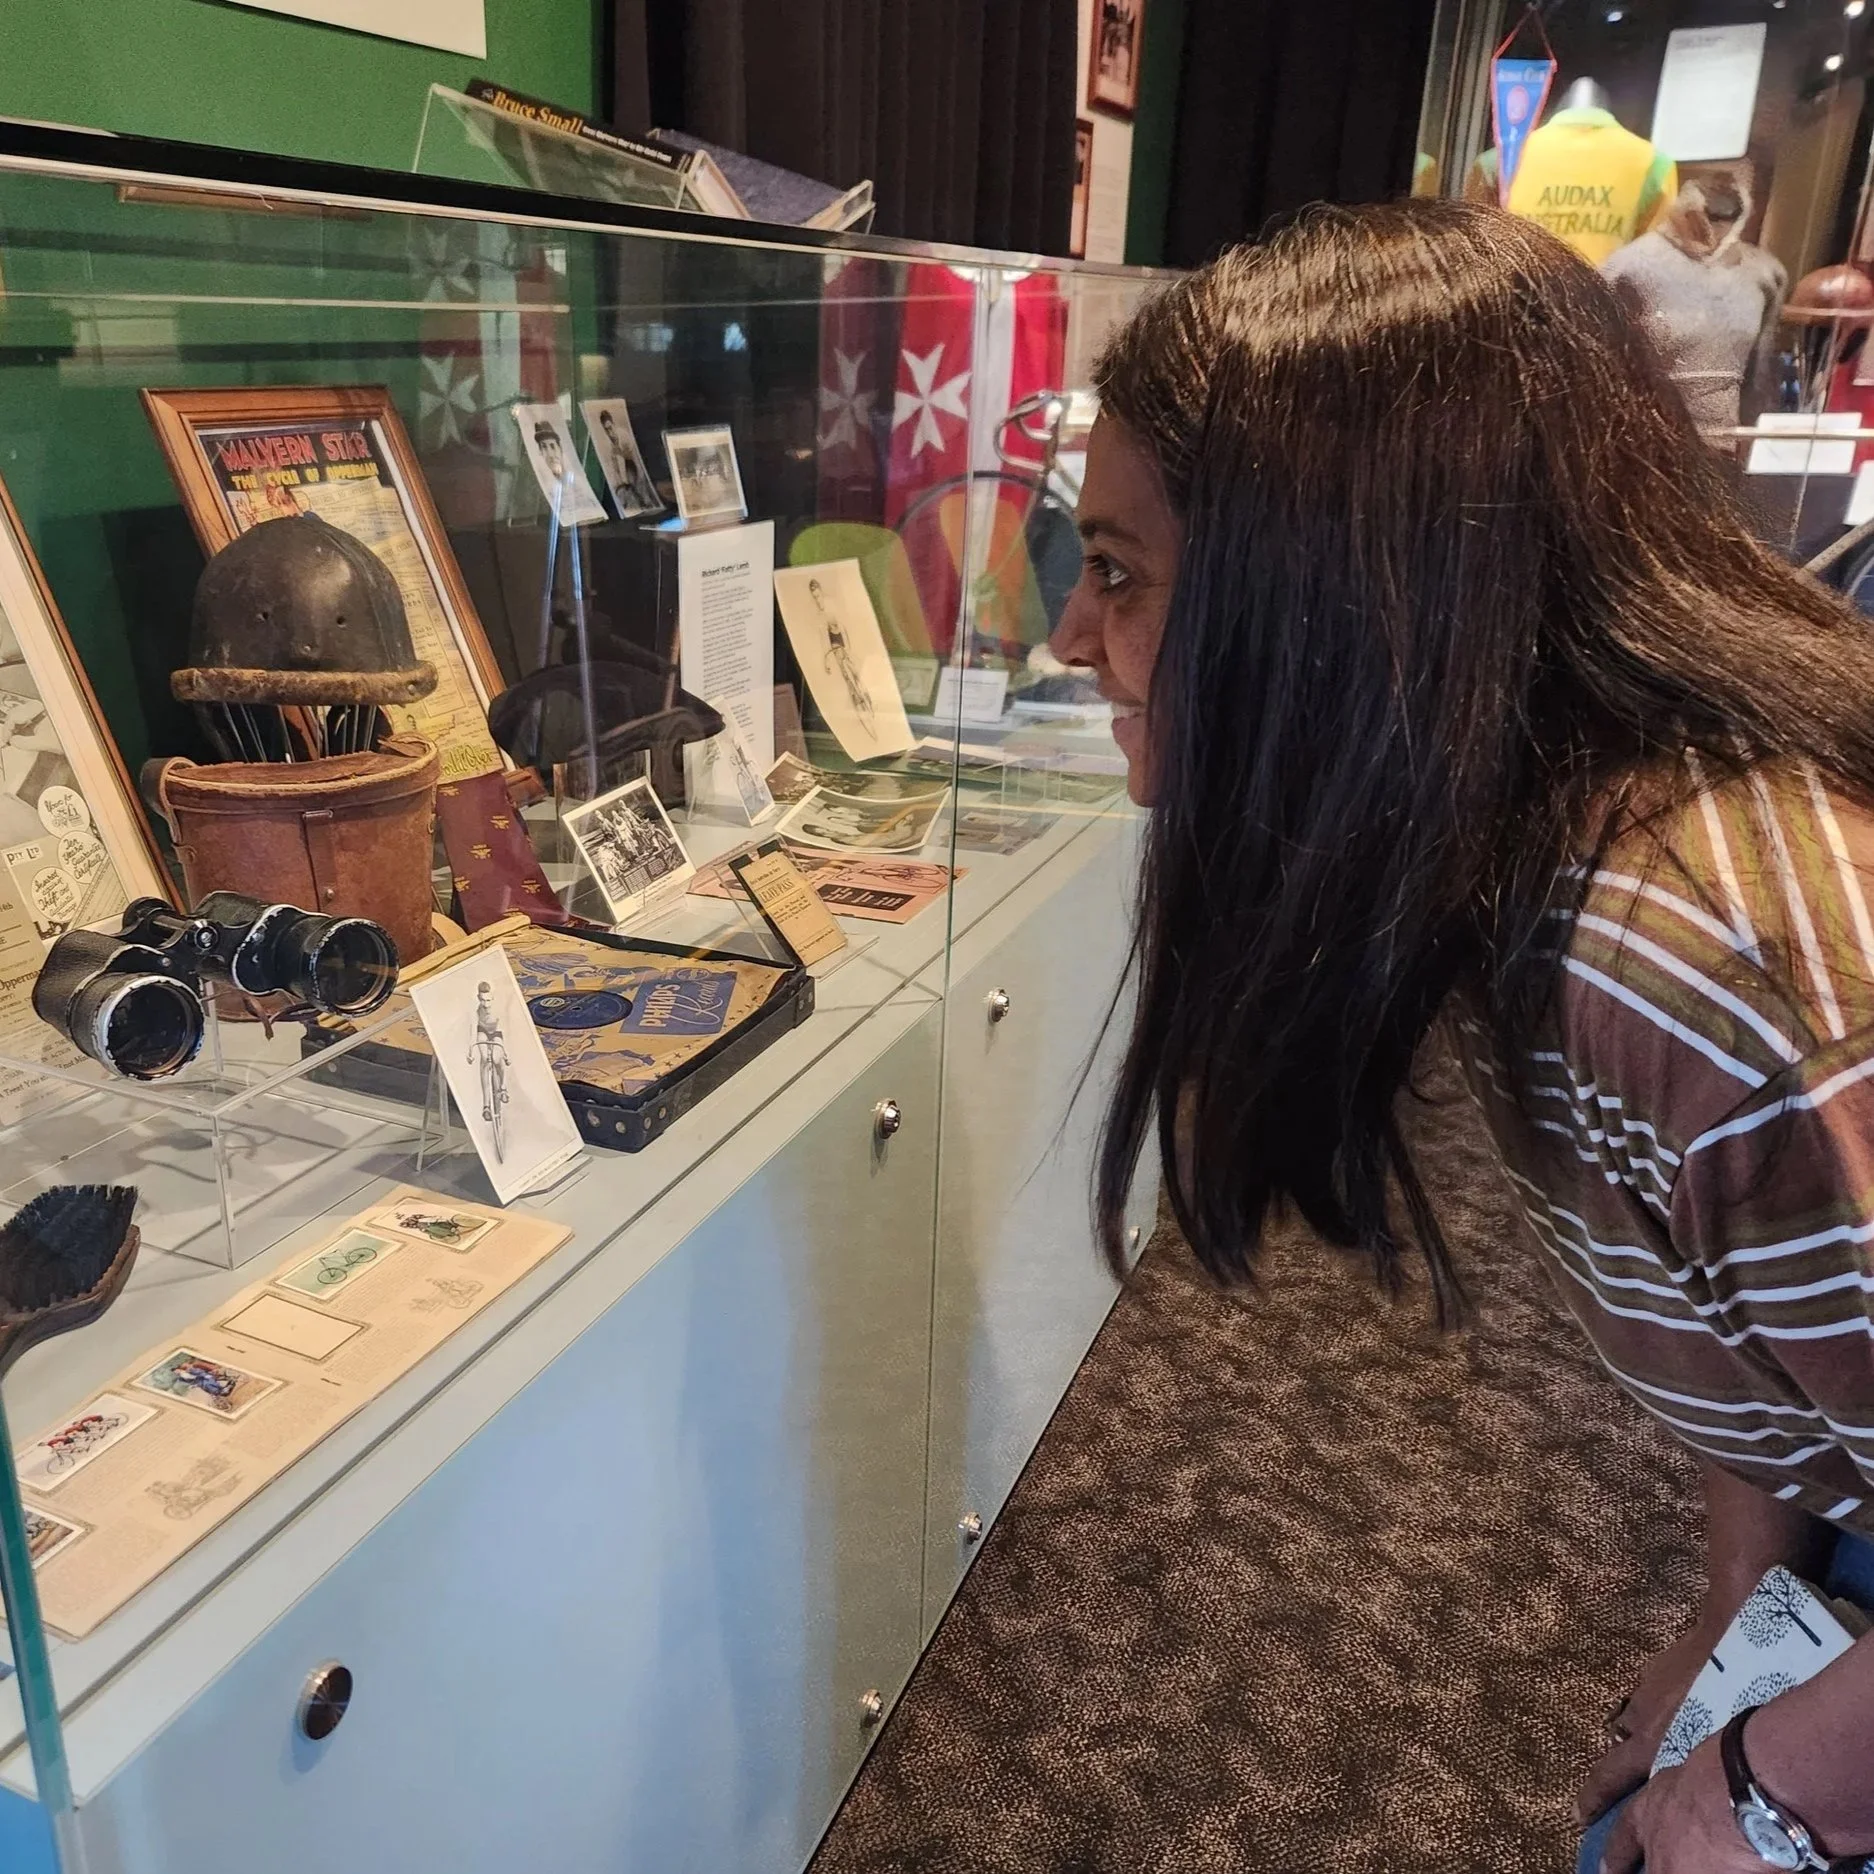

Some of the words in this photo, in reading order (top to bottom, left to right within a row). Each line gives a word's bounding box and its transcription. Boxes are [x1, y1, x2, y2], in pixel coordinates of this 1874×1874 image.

[493, 91, 535, 119] Bruce
[539, 106, 584, 134] Small
[1537, 185, 1615, 208] AUDAX
[218, 434, 319, 471] MALVERN
[322, 431, 373, 462] STAR
[231, 474, 259, 490] THE
[267, 468, 300, 487] CYCLE
[38, 890, 60, 911] Theft
[760, 885, 779, 904] LEAVE
[777, 878, 796, 895] PASS
[0, 969, 42, 991] Opperma
[639, 984, 680, 1027] PHILIPS
